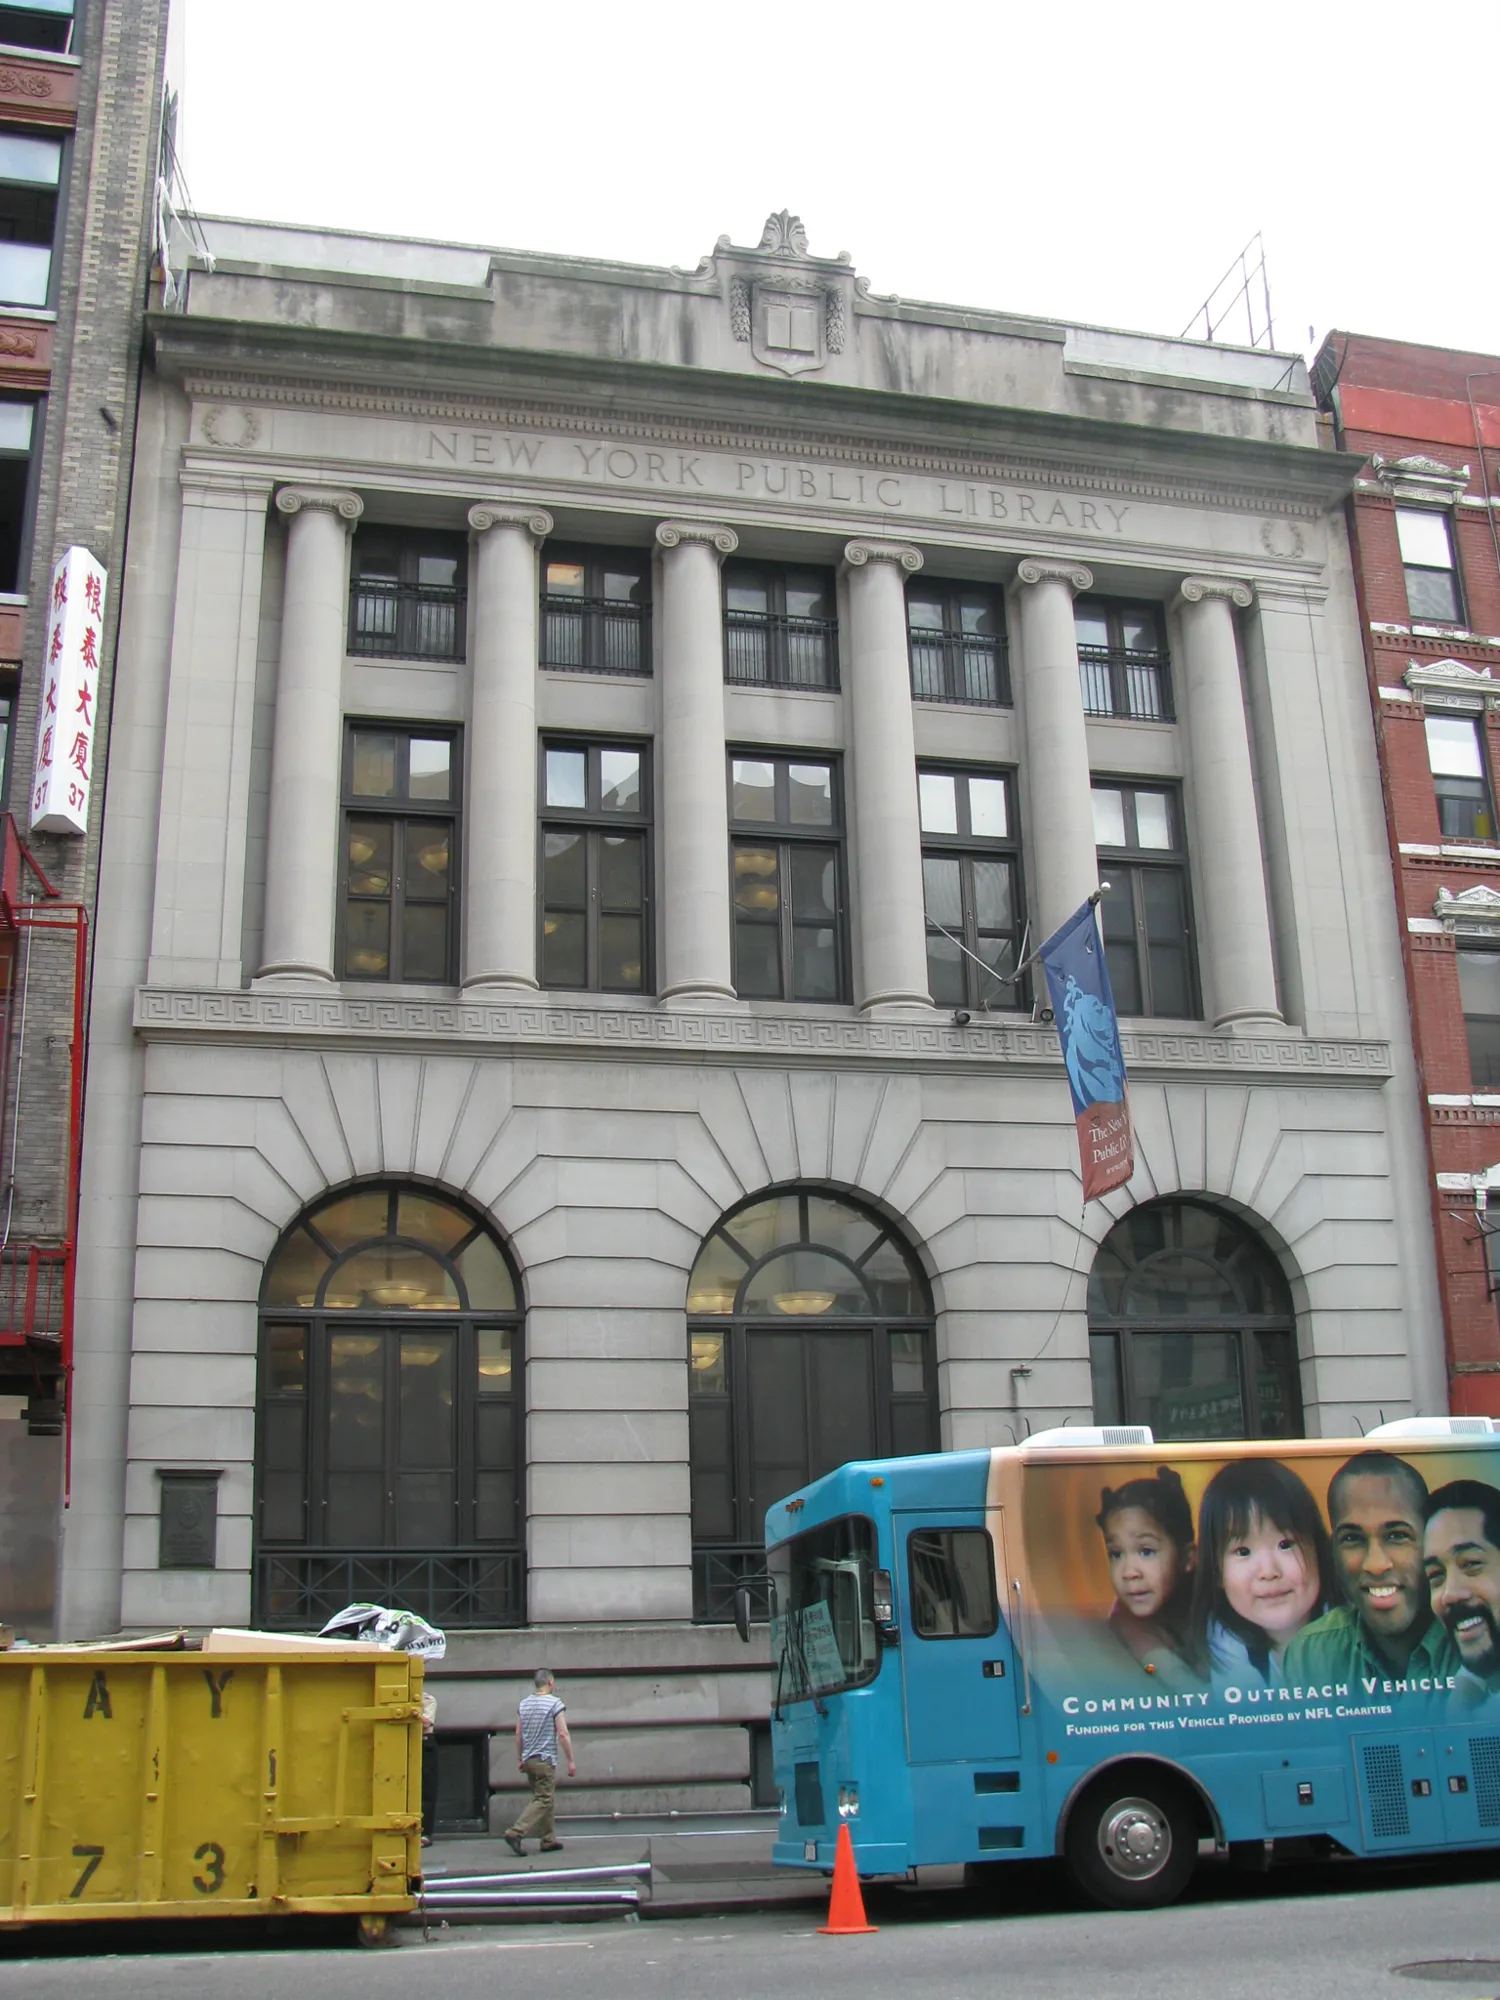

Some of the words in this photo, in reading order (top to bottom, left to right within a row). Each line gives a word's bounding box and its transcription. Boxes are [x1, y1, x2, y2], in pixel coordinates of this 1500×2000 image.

[425, 430, 544, 469] NEW
[573, 445, 704, 486] YORK
[735, 462, 902, 507] PUBLIC
[938, 484, 1130, 532] LIBRARY
[34, 780, 48, 810] 37
[68, 783, 85, 811] 37
[1088, 1125, 1108, 1143] The
[1092, 1142, 1119, 1164] Public
[1062, 1692, 1209, 1714] COMMUNITY
[1224, 1683, 1348, 1704] OUTREACH
[1361, 1676, 1456, 1694] VEHICLE
[1066, 1724, 1120, 1736] FUNDING
[1124, 1722, 1146, 1732] FOR
[1149, 1720, 1175, 1730] THIS
[1177, 1716, 1225, 1728] VEHICLE
[1228, 1713, 1284, 1725] PROVIDED
[1287, 1712, 1302, 1721] BY
[1305, 1707, 1333, 1720] NFL
[1336, 1705, 1392, 1717] CHARITIES
[69, 1845, 105, 1898] 7
[192, 1842, 225, 1894] 3
